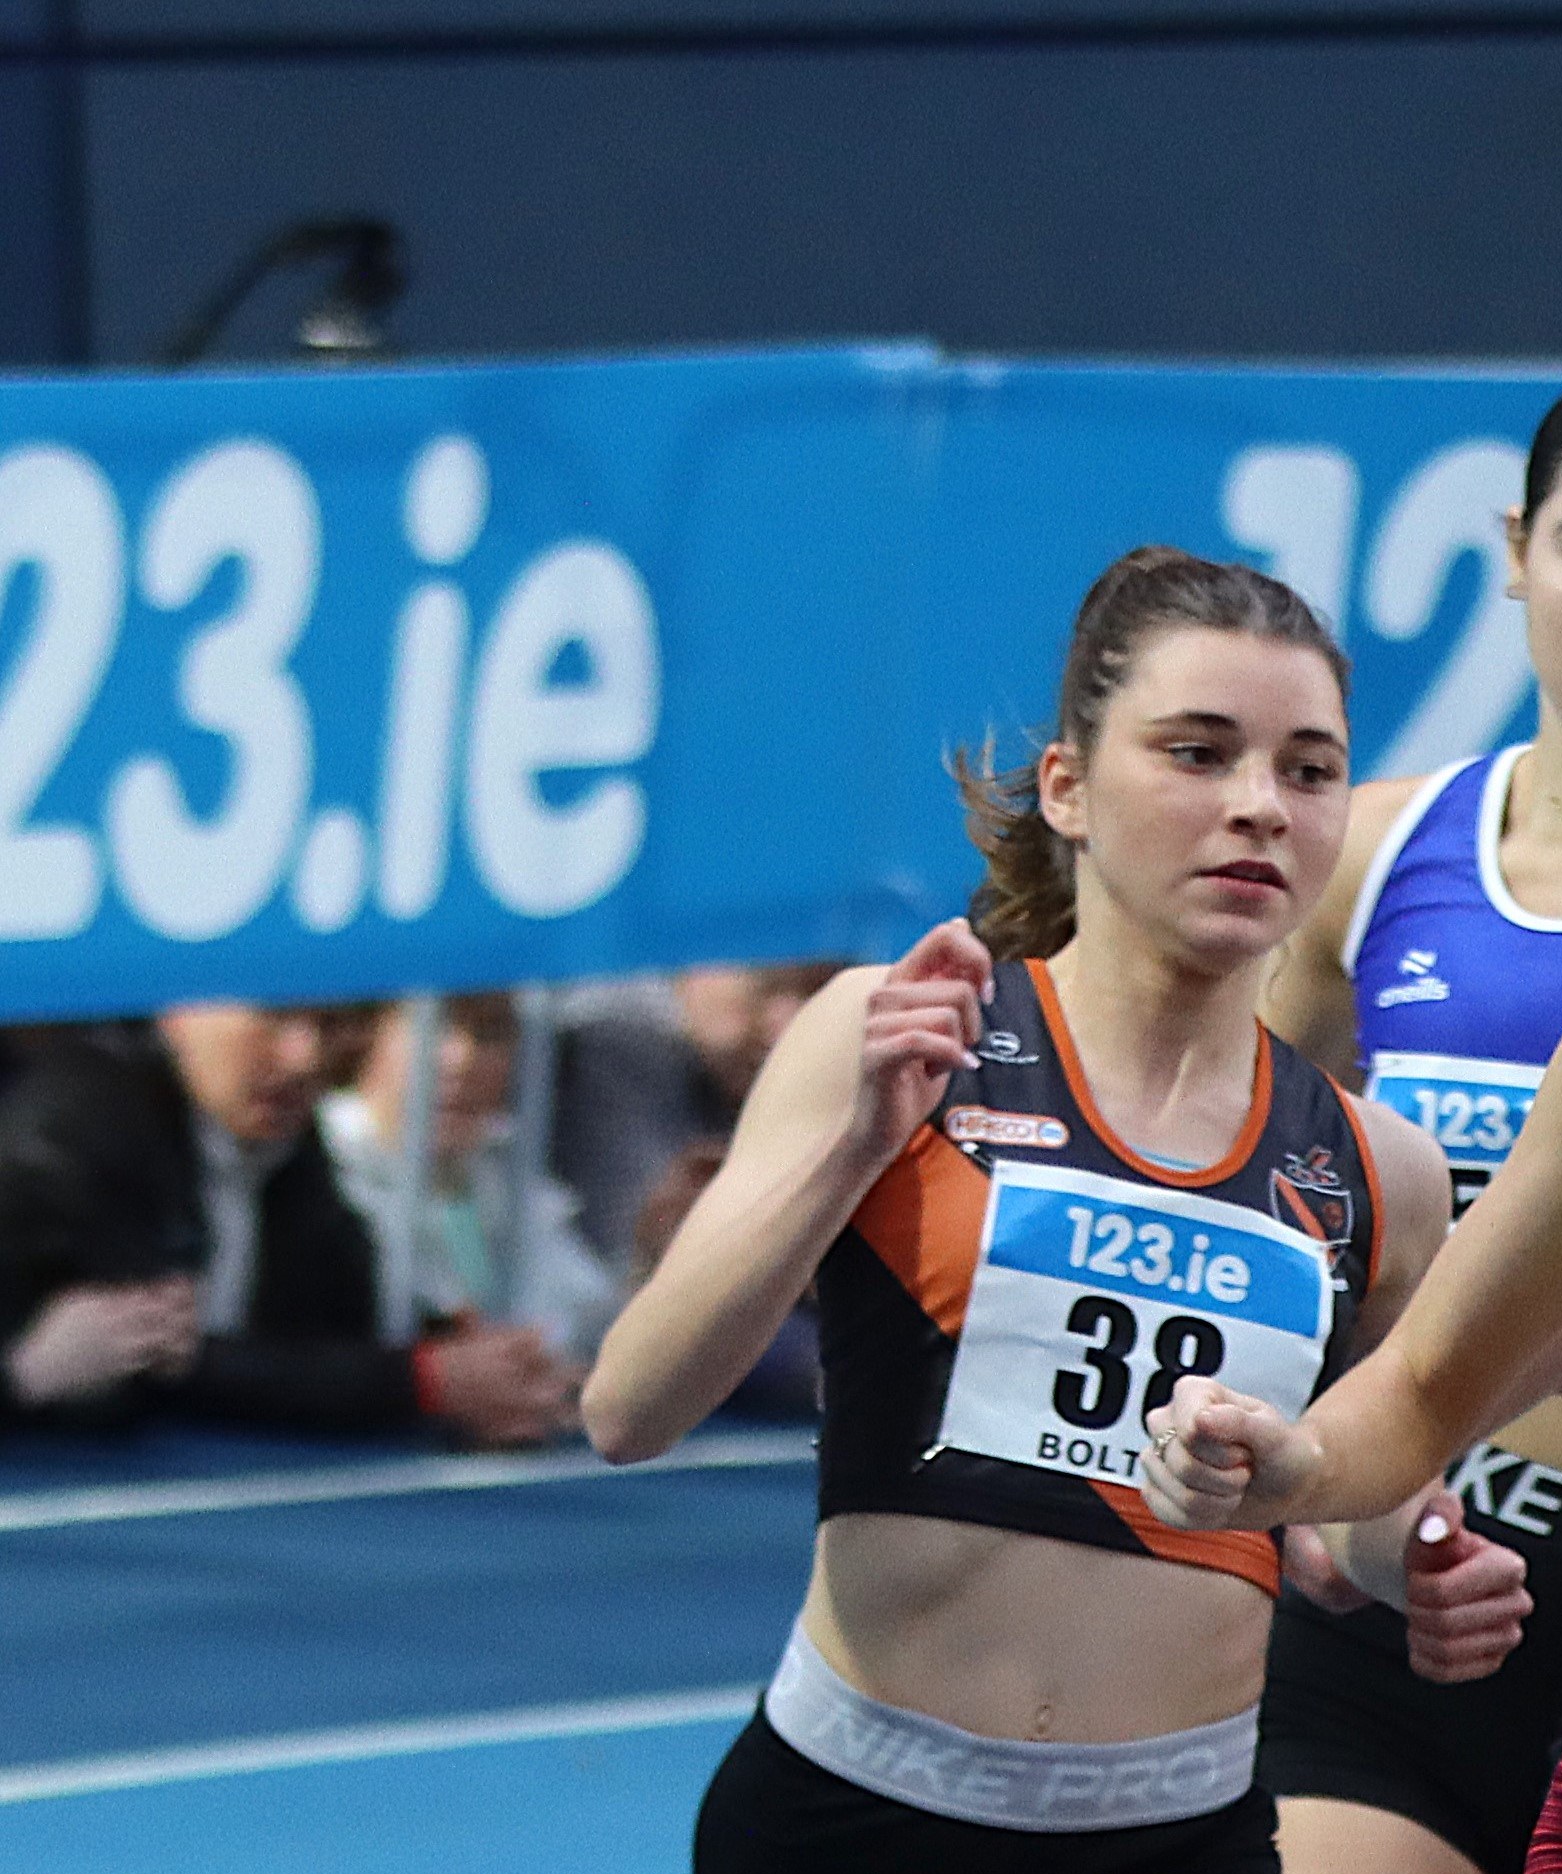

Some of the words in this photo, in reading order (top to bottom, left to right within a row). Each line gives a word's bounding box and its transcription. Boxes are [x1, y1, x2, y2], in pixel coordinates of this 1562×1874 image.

[1067, 1205, 1252, 1304] 123.ie
[1053, 1296, 1226, 1431] 38
[813, 1701, 1030, 1808] NIKE
[1037, 1744, 1221, 1814] PRO
